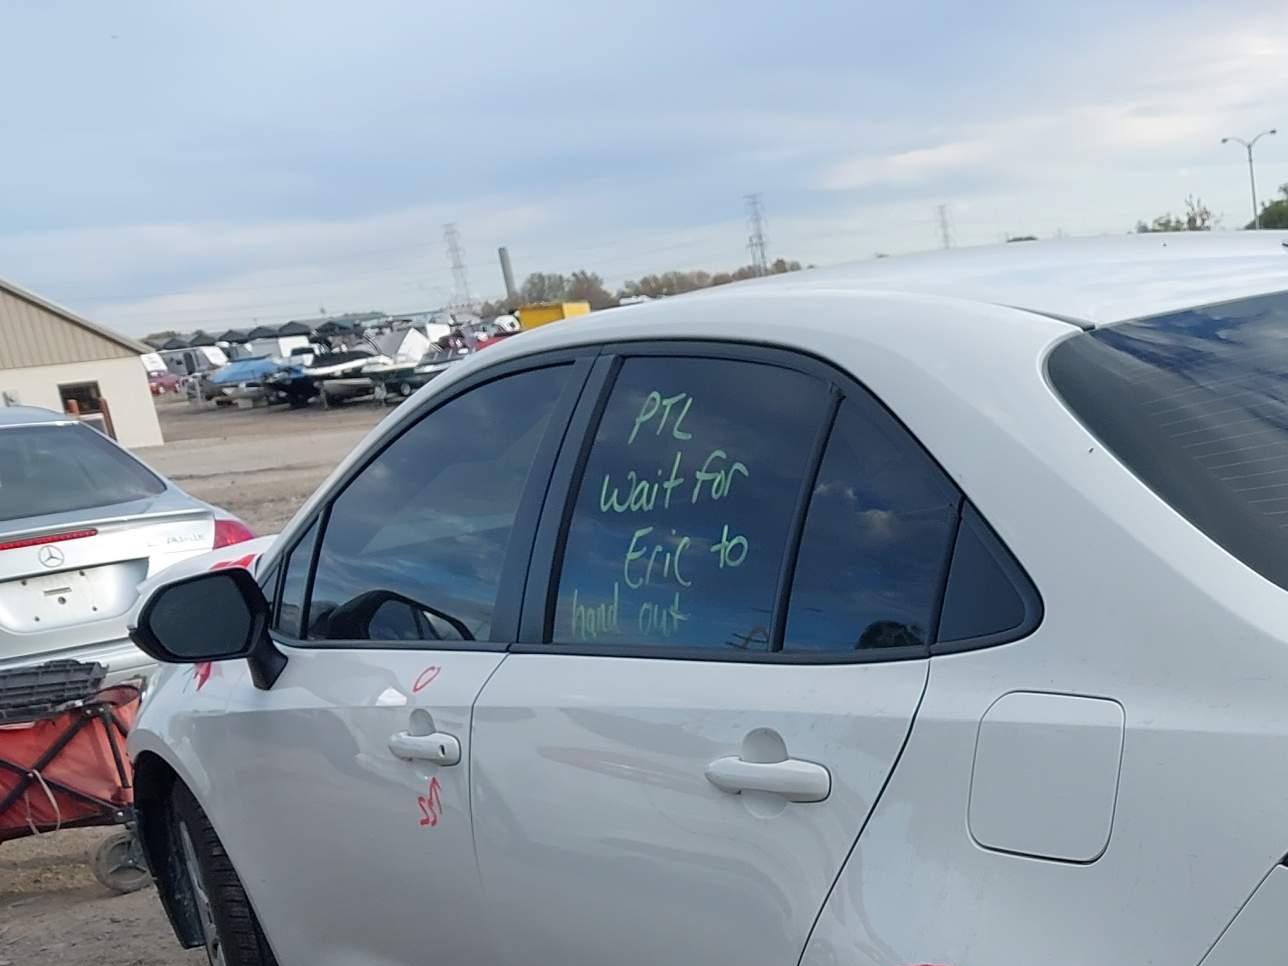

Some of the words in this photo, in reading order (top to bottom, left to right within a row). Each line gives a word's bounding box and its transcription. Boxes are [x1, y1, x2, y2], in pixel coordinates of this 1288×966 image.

[627, 390, 693, 444] PTL
[710, 524, 749, 569] to
[571, 581, 619, 641] hand
[638, 592, 690, 638] out
